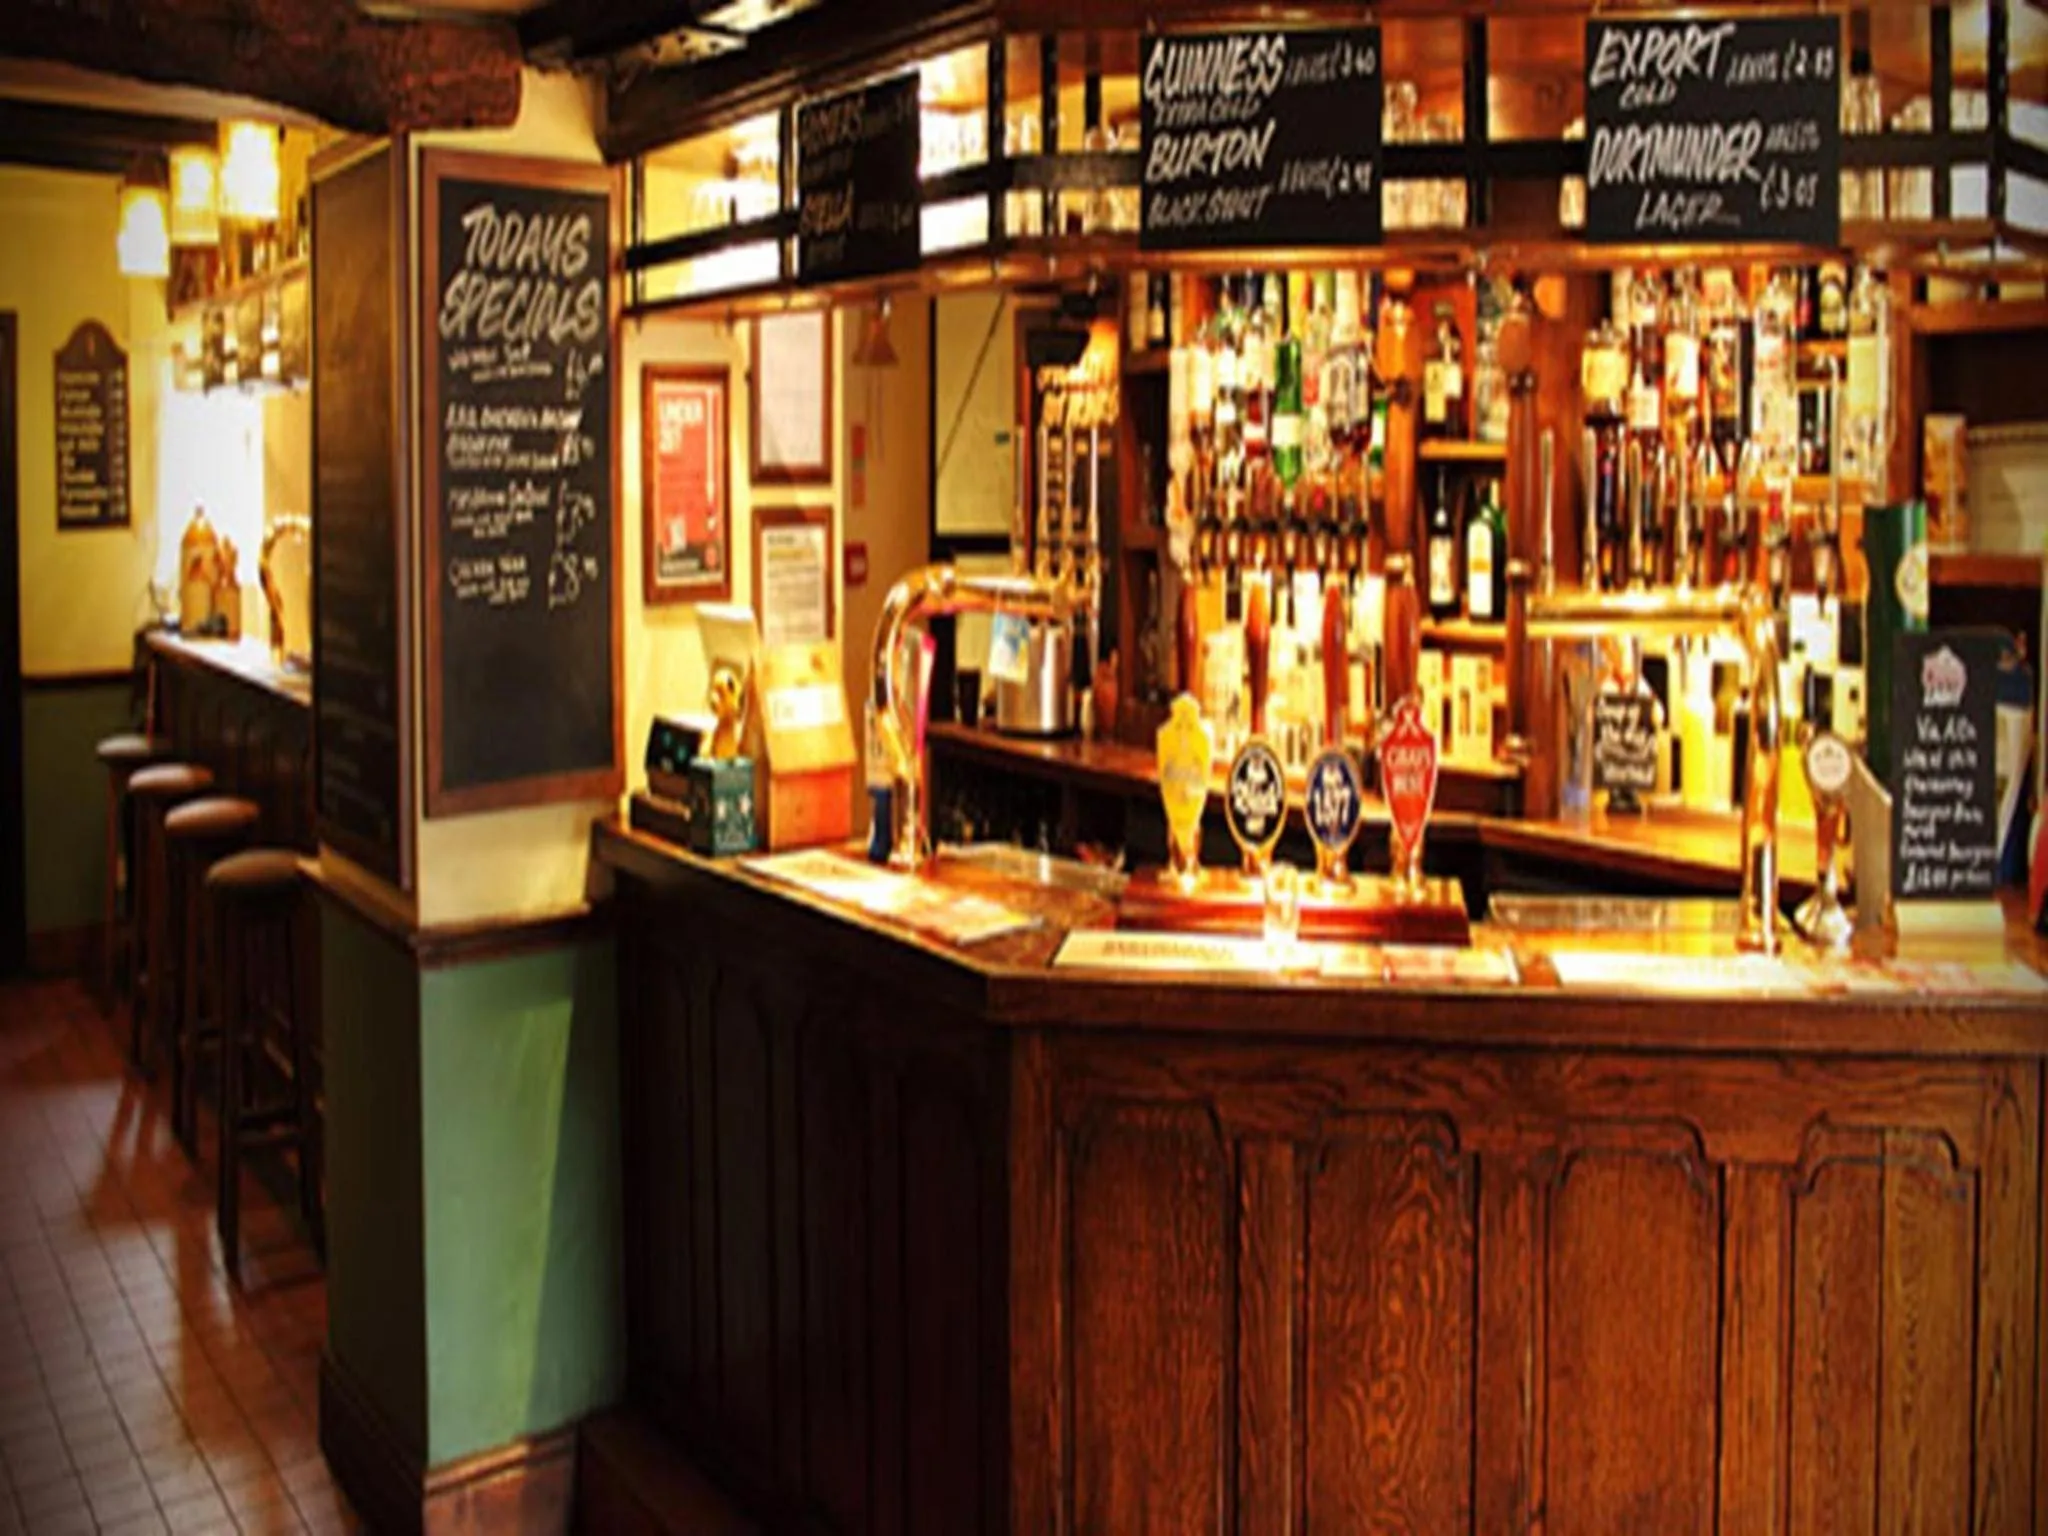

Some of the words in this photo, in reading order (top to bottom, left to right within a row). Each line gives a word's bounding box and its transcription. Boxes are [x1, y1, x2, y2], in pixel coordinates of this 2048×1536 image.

[1143, 34, 1286, 100] GUINNESS
[1590, 22, 1736, 87] EXPORT
[1145, 118, 1276, 183] BURTON
[1588, 120, 1762, 189] DORTMUNDER
[461, 203, 592, 279] TODAYS
[439, 269, 602, 346] SPECIALS
